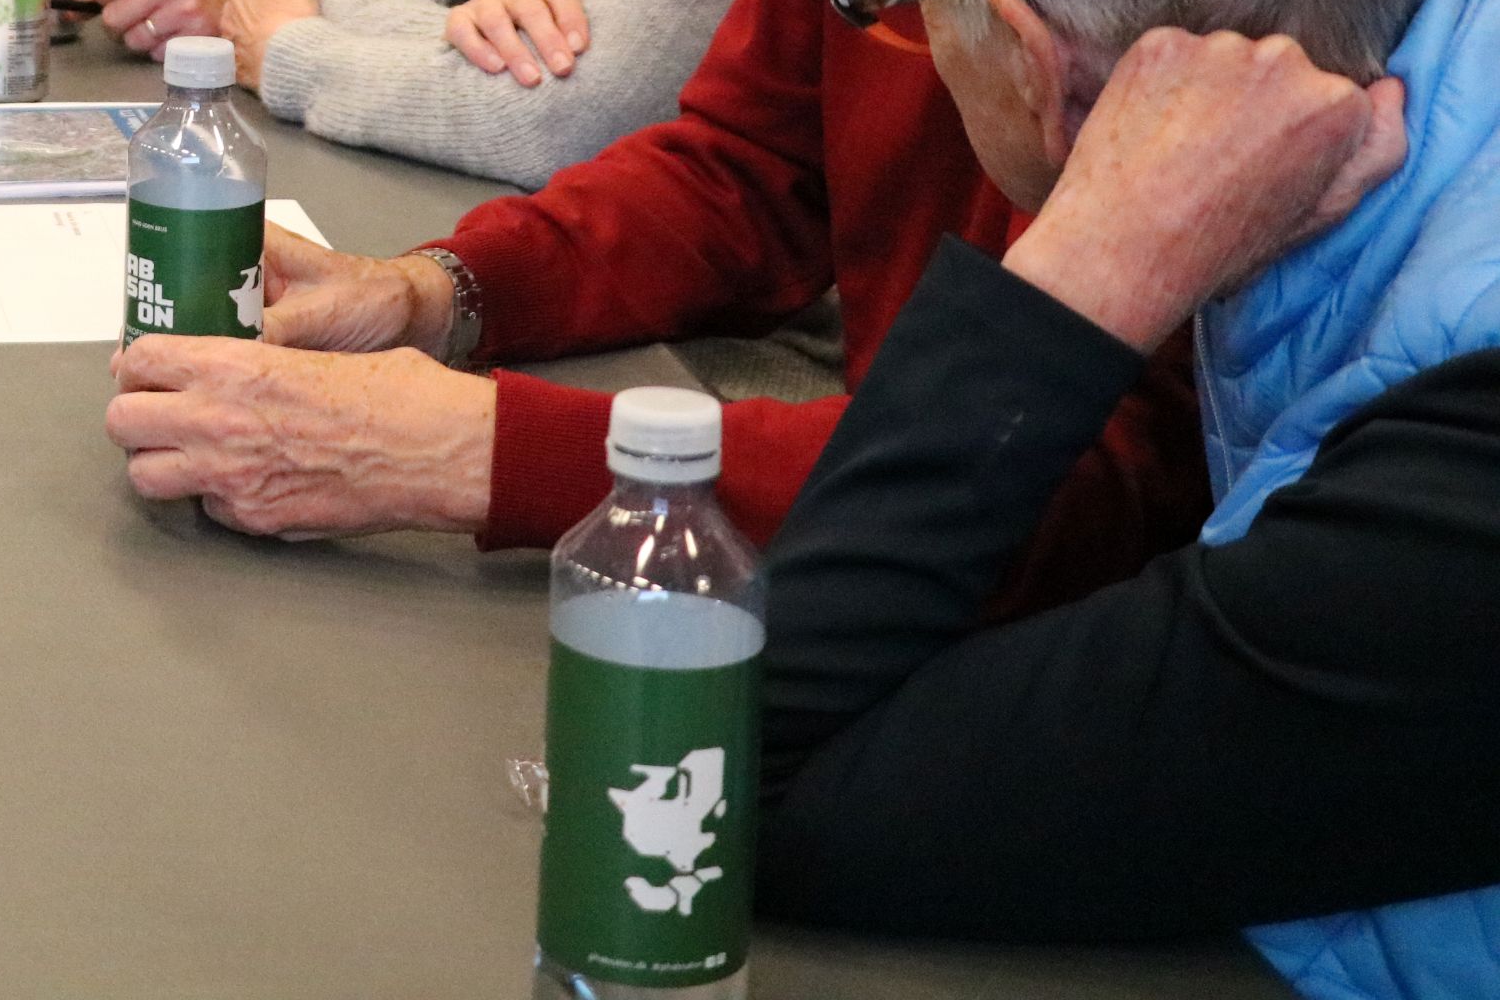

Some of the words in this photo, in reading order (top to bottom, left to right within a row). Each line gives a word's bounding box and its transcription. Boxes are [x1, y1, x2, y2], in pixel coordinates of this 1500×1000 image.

[128, 253, 154, 281] AB
[127, 275, 174, 307] SAL
[138, 301, 174, 329] ON
